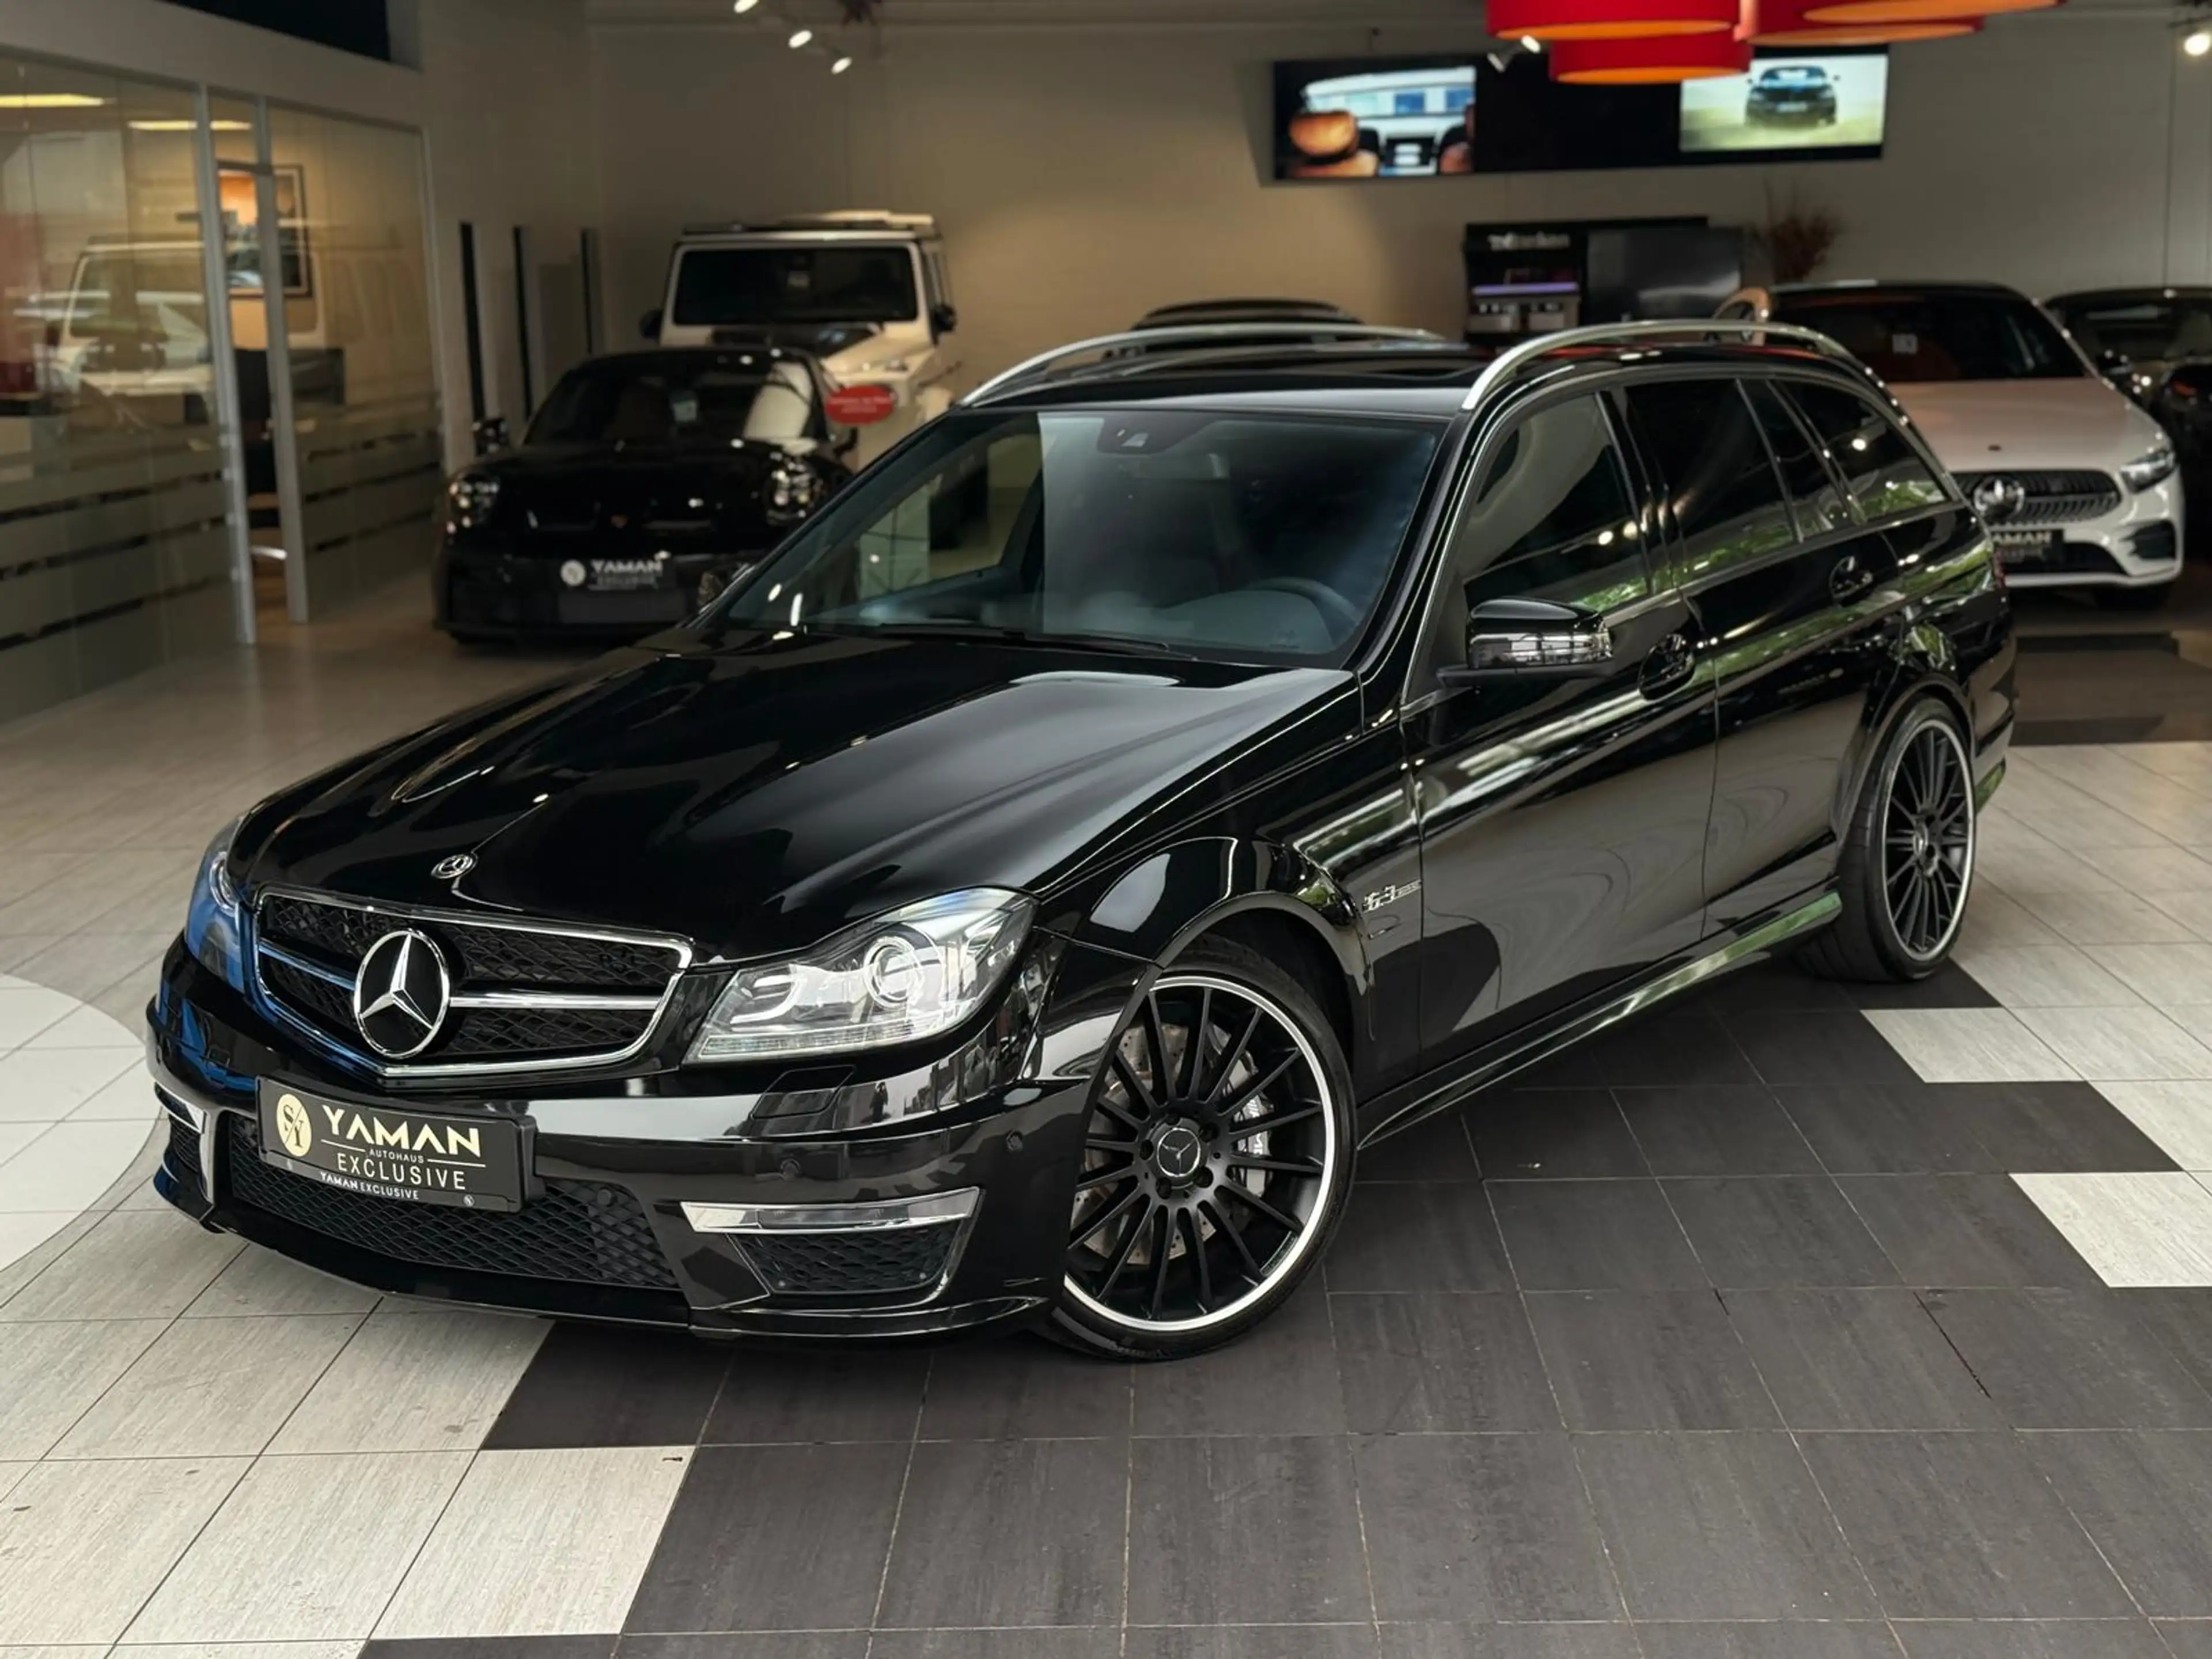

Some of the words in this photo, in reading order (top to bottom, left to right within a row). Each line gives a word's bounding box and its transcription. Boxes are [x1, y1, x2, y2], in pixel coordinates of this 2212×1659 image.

[590, 559, 663, 574] YAMAN
[322, 1104, 481, 1157] YAMAN
[369, 1149, 425, 1164] AUTOHAUS
[320, 1171, 359, 1190] YAMAN
[360, 1181, 419, 1200] EXCLUSIVE
[338, 1153, 466, 1190] EXCLUSIVE
